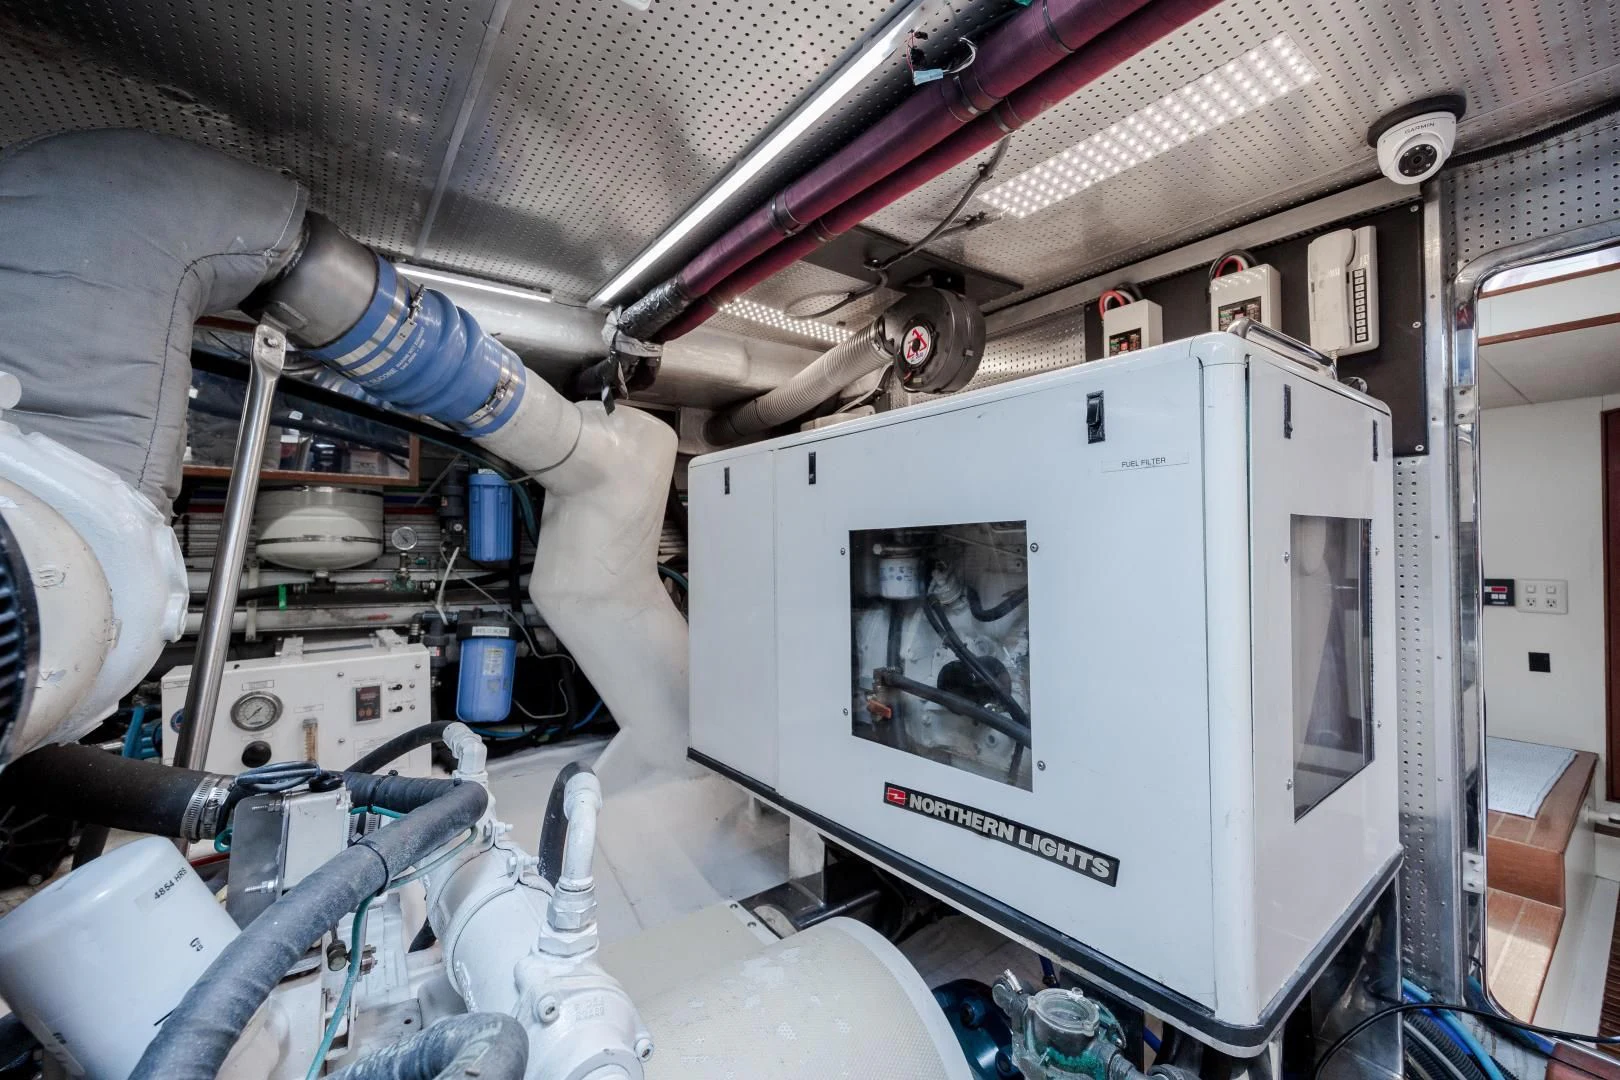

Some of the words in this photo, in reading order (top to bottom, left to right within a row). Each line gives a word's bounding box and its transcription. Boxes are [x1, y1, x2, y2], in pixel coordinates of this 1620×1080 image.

[1121, 460, 1139, 468] FUEL
[1140, 457, 1166, 466] FILTER
[909, 793, 1015, 842] NORTHERN
[1018, 828, 1110, 878] LIGHTS
[154, 879, 175, 899] 4854
